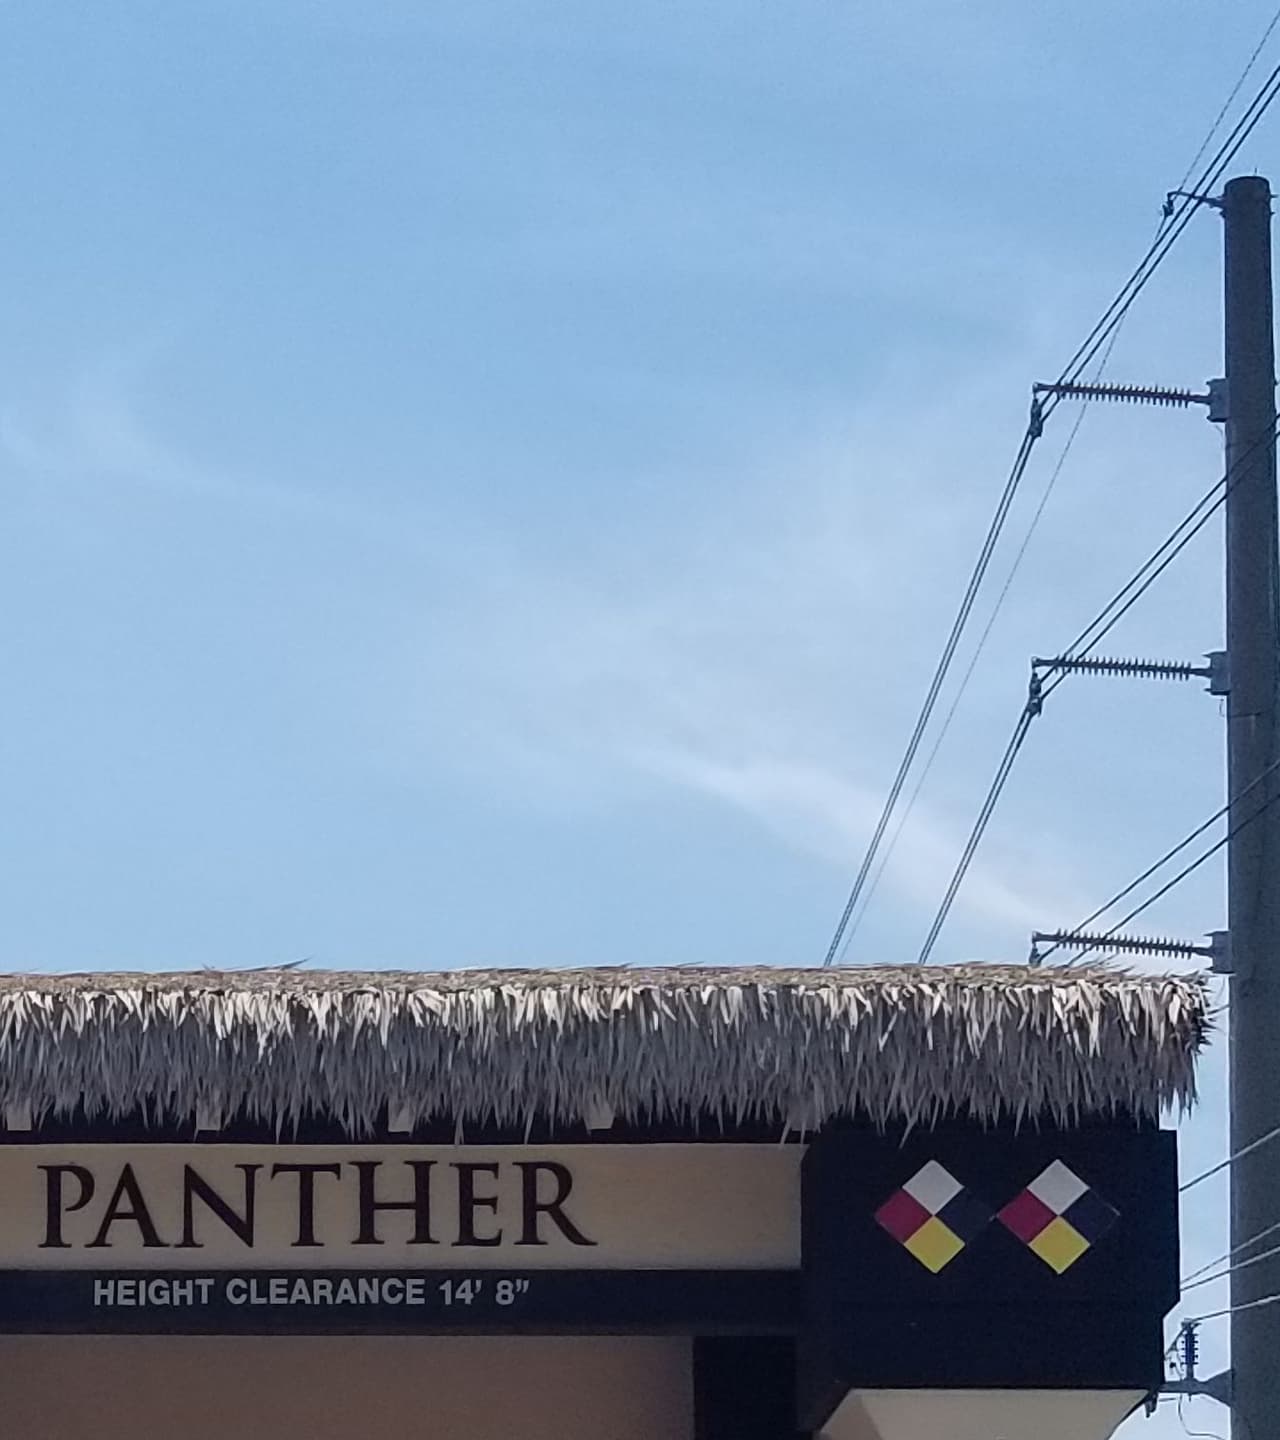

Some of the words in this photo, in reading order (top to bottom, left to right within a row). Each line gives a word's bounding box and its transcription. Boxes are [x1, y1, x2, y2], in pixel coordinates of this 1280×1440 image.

[37, 1160, 598, 1249] PANTHER
[93, 1279, 214, 1306] HEIGHT
[226, 1279, 425, 1306] CLEARANCE
